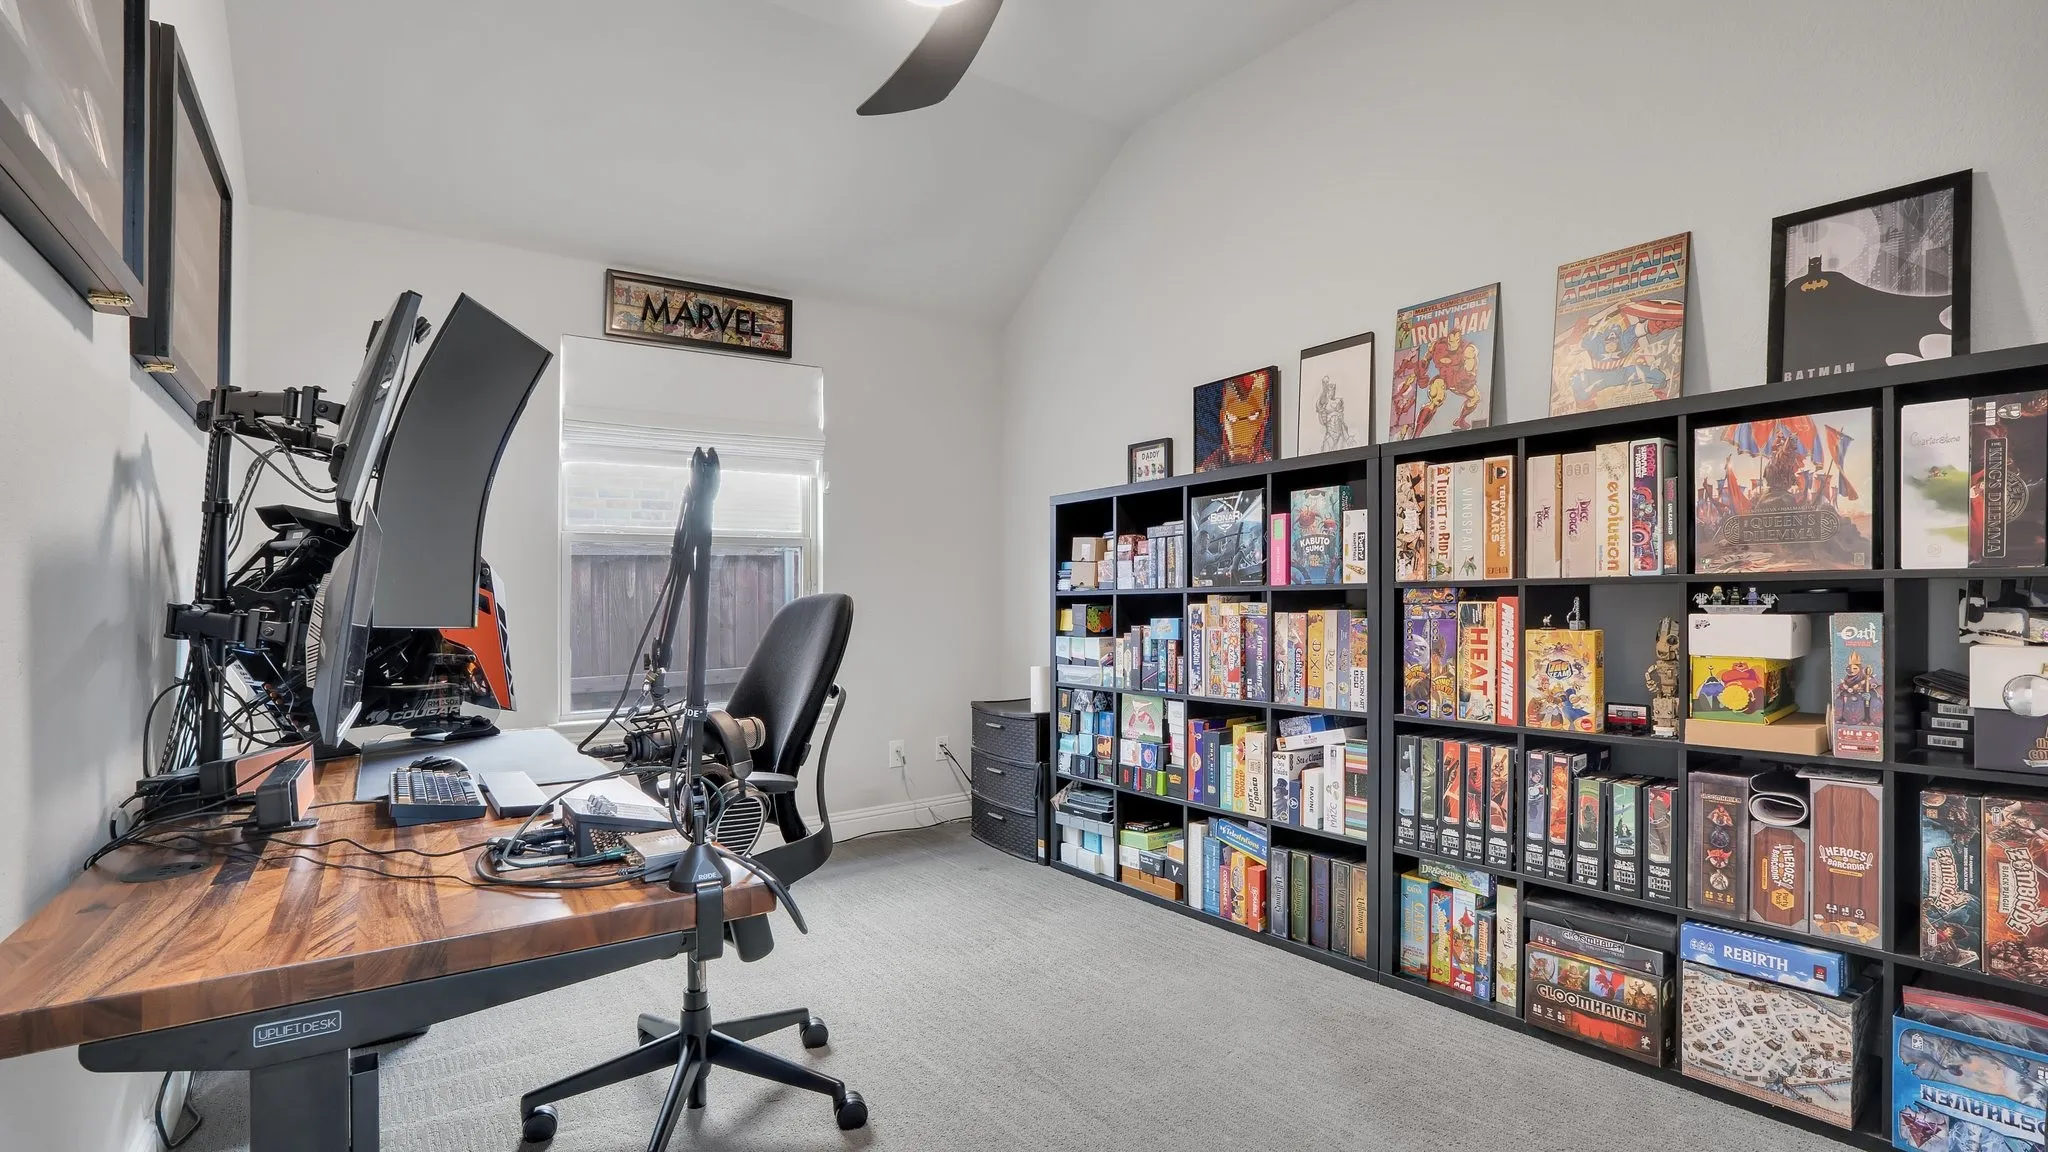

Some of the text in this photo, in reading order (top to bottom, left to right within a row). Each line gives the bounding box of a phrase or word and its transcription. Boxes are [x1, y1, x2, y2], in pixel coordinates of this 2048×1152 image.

[641, 293, 763, 338] MARVEL
[1415, 292, 1489, 314] MARVEL COMICS GROUP
[1416, 298, 1488, 322] THE INVINCIBLE
[1411, 308, 1493, 346] IRON MAN
[1783, 362, 1855, 382] BATMAN
[1910, 432, 1961, 447] Charterstone
[1141, 450, 1160, 460] DADDY
[1988, 447, 2003, 488] KING'S
[1436, 478, 1451, 559] TICKET TO RIDE
[1461, 487, 1473, 552] WINGSPAN
[1490, 500, 1500, 542] MARS
[1566, 507, 1578, 536] FORGE
[1578, 498, 1591, 522] DICE
[1750, 513, 1816, 529] QUEEN'S
[1987, 491, 2002, 553] DILEMMA
[1606, 480, 1624, 571] evolution
[1743, 528, 1817, 542] DILEMMA
[1300, 537, 1330, 547] KABUTO
[1305, 545, 1325, 553] SUMO
[1357, 532, 1365, 560] Poetry
[1840, 622, 1878, 644] Oath
[1192, 633, 1201, 670] SANTORINI
[1470, 628, 1488, 696] HEAT
[1501, 602, 1515, 720] MAGICAL ATHLETE
[1294, 647, 1303, 695] Castle Panic
[391, 706, 460, 721] COUGAR
[1249, 791, 1257, 812] LOOT
[1254, 777, 1262, 805] LOADED
[1226, 828, 1260, 849] Telestrations
[1770, 848, 1779, 881] BARCADIA
[1783, 848, 1795, 887] HEROES
[1824, 846, 1868, 862] HEROES
[1827, 858, 1865, 871] BARCADIA
[1421, 864, 1465, 881] DRAGOMINO
[1934, 847, 1961, 912] ZOMBICIDE
[2002, 865, 2010, 912] BLACK PLAGUE
[2007, 847, 2039, 935] ZOMBICIDE
[1413, 902, 1425, 943] CATAN
[1478, 920, 1489, 965] PANDEMIC
[1561, 930, 1625, 954] GLOOMHAVEN
[1723, 945, 1788, 972] REBIRTH
[1536, 984, 1647, 1028] GLOOMHAVEN
[258, 1017, 337, 1040] UPLIFT DESK
